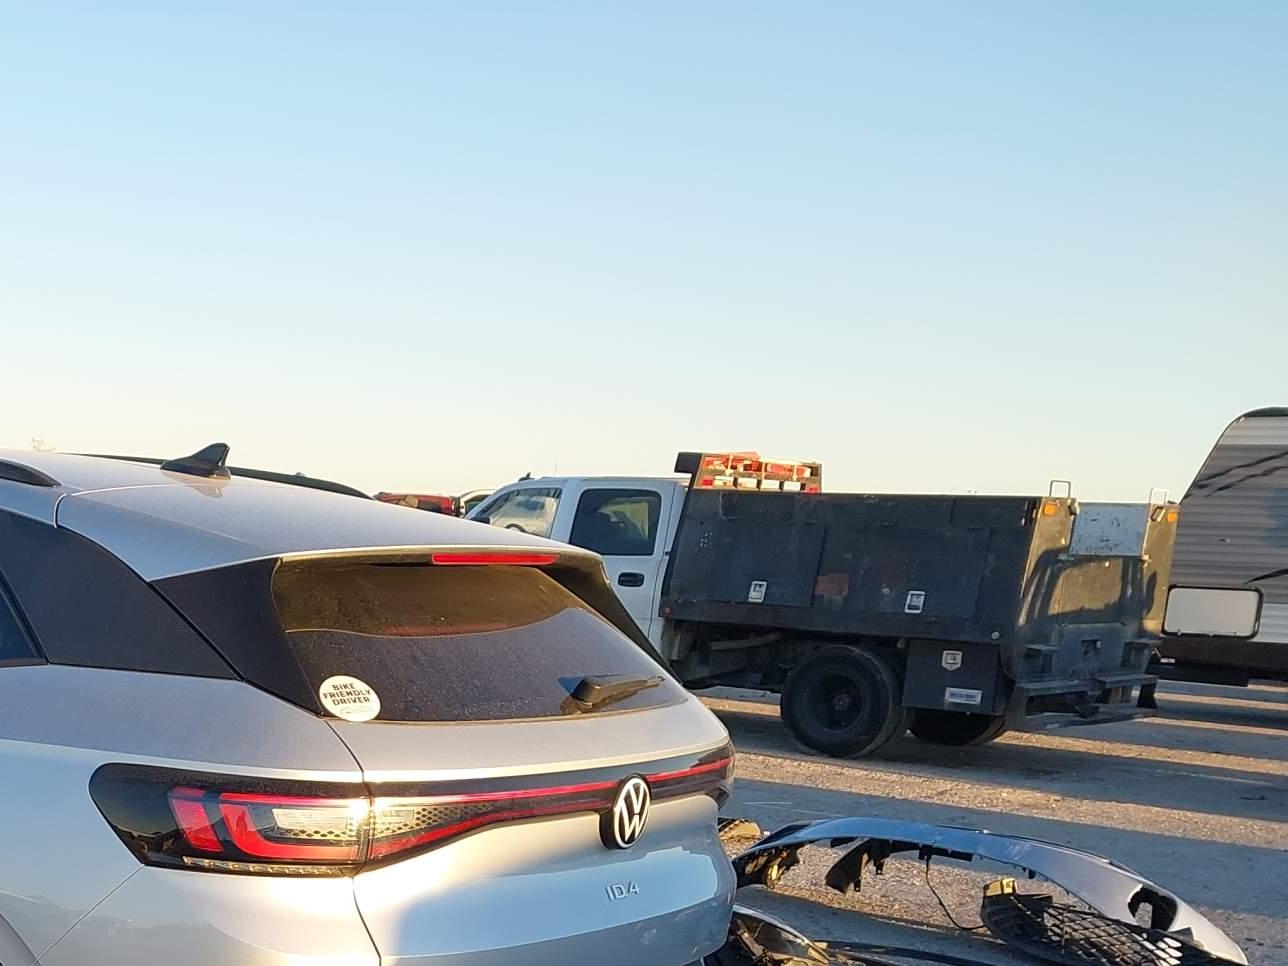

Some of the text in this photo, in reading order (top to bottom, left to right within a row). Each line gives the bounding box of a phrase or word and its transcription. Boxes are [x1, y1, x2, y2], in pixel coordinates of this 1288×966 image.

[332, 683, 356, 691] BIKE
[323, 689, 371, 700] FRIENDLY
[332, 696, 371, 706] DRIVER
